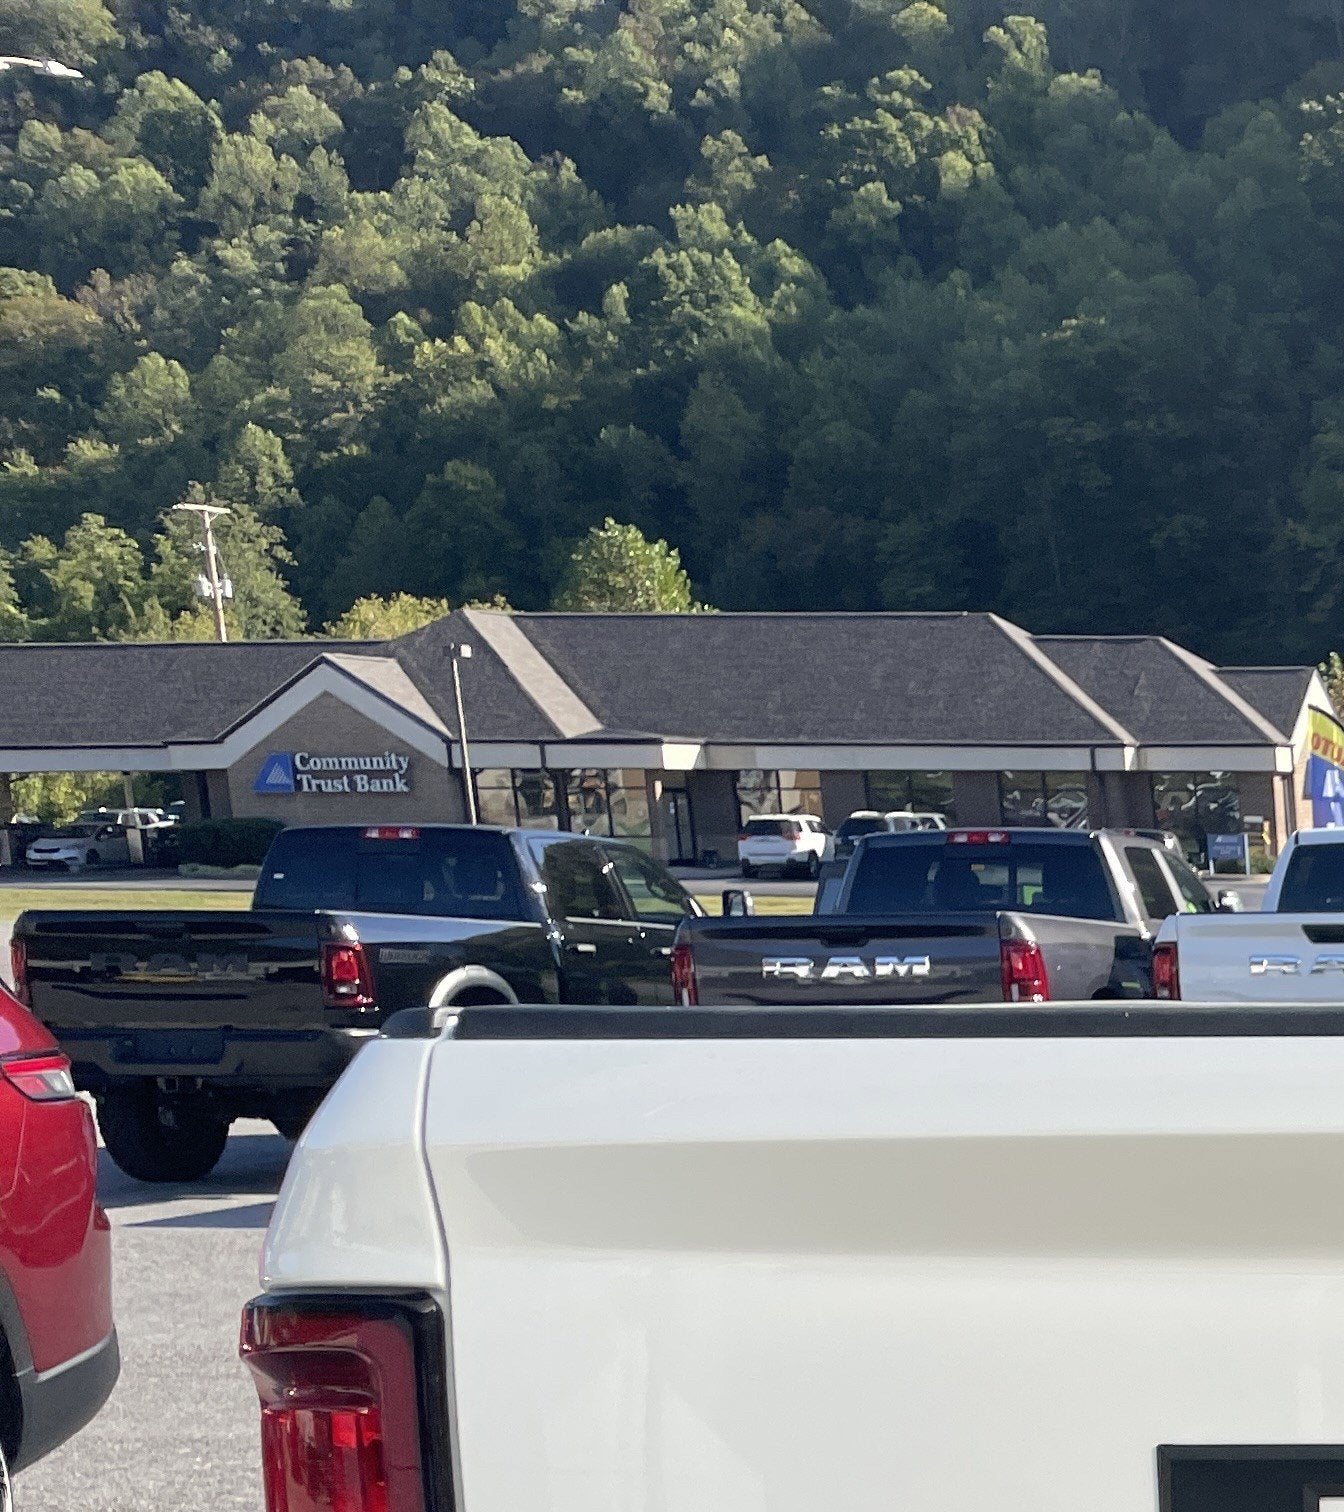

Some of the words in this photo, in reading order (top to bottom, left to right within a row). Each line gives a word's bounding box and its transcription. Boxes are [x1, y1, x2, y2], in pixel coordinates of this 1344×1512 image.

[294, 751, 410, 775] Community
[297, 774, 350, 793] Trust
[353, 773, 410, 793] Bank
[762, 956, 930, 979] RAM
